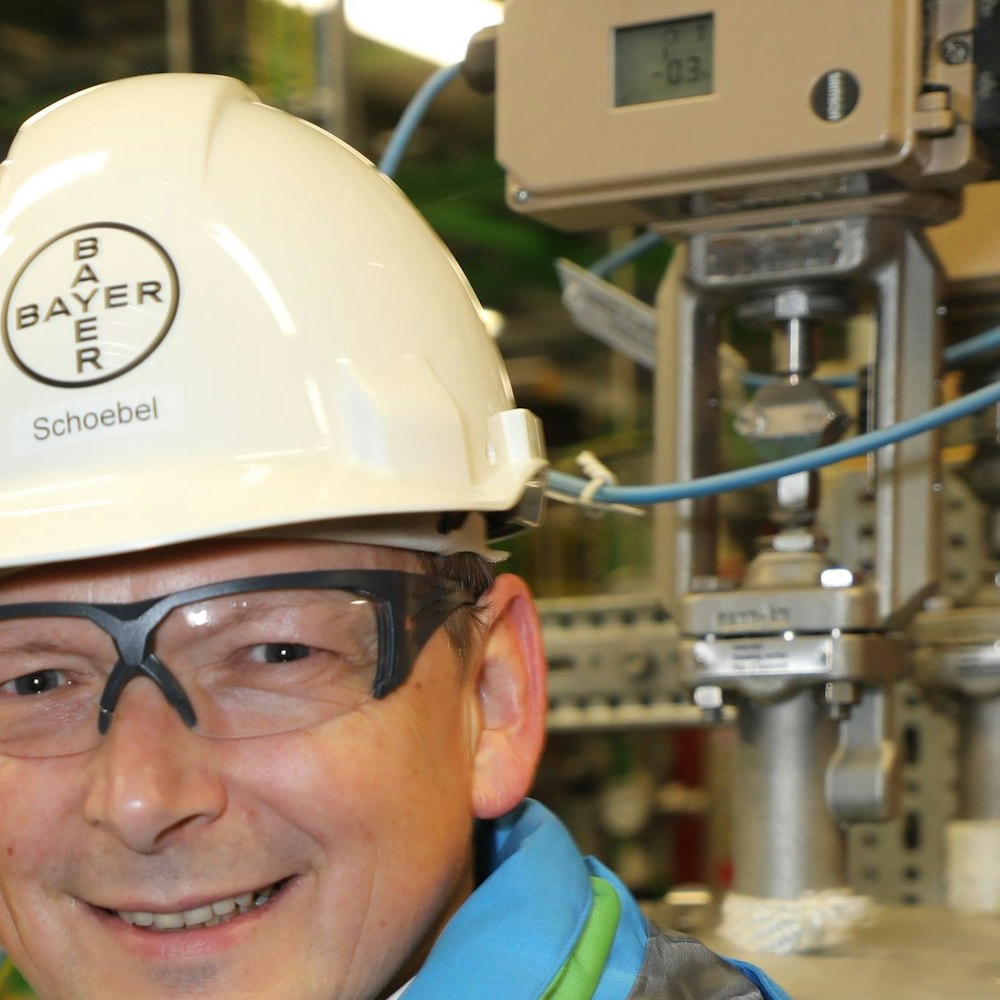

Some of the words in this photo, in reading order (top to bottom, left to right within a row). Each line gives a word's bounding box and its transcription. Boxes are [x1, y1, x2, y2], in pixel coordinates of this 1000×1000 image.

[16, 281, 163, 329] BAYER
[73, 237, 103, 373] BAYER
[33, 397, 158, 441] Schoebel
